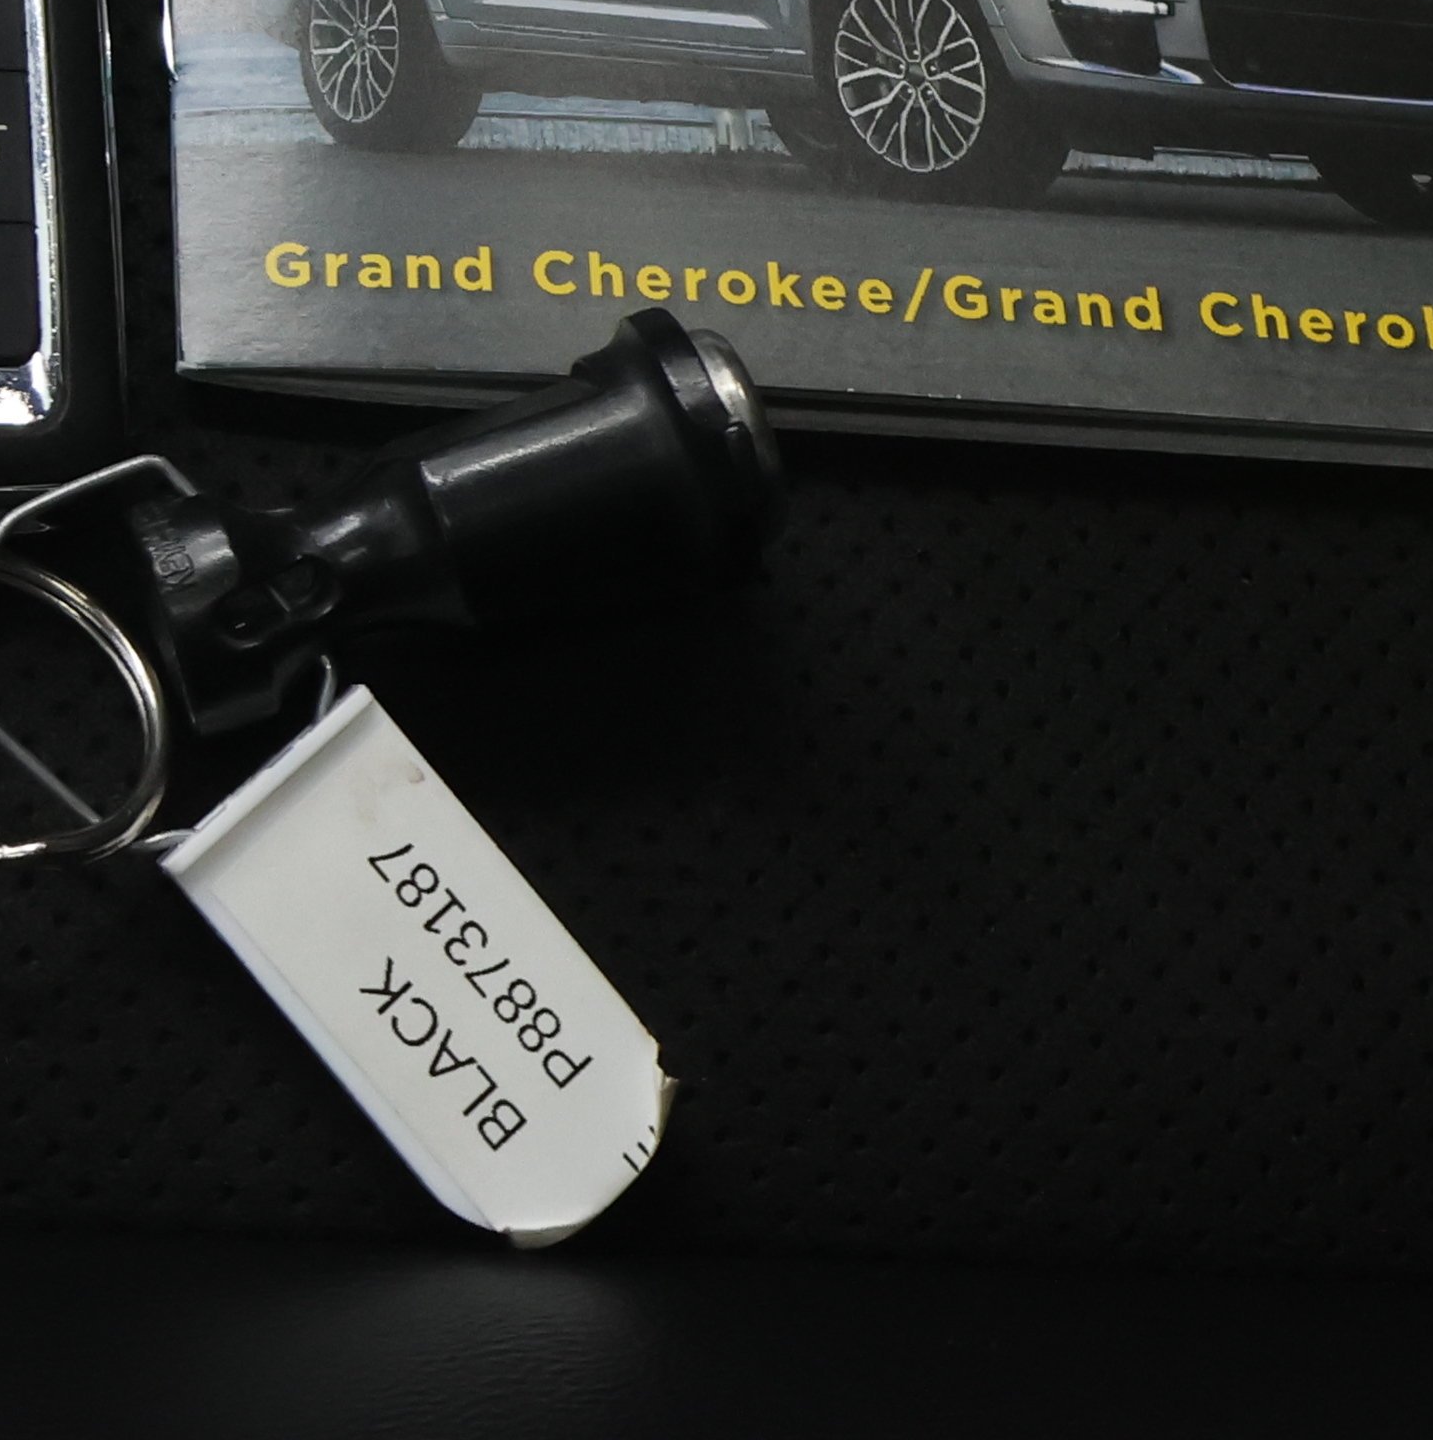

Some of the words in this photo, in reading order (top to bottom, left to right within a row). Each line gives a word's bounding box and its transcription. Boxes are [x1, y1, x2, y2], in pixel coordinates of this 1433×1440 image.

[264, 242, 493, 292] Grand
[532, 249, 1162, 331] Cherokee/Grand
[360, 958, 528, 1151] BLACK
[367, 842, 592, 1089] P8873187
